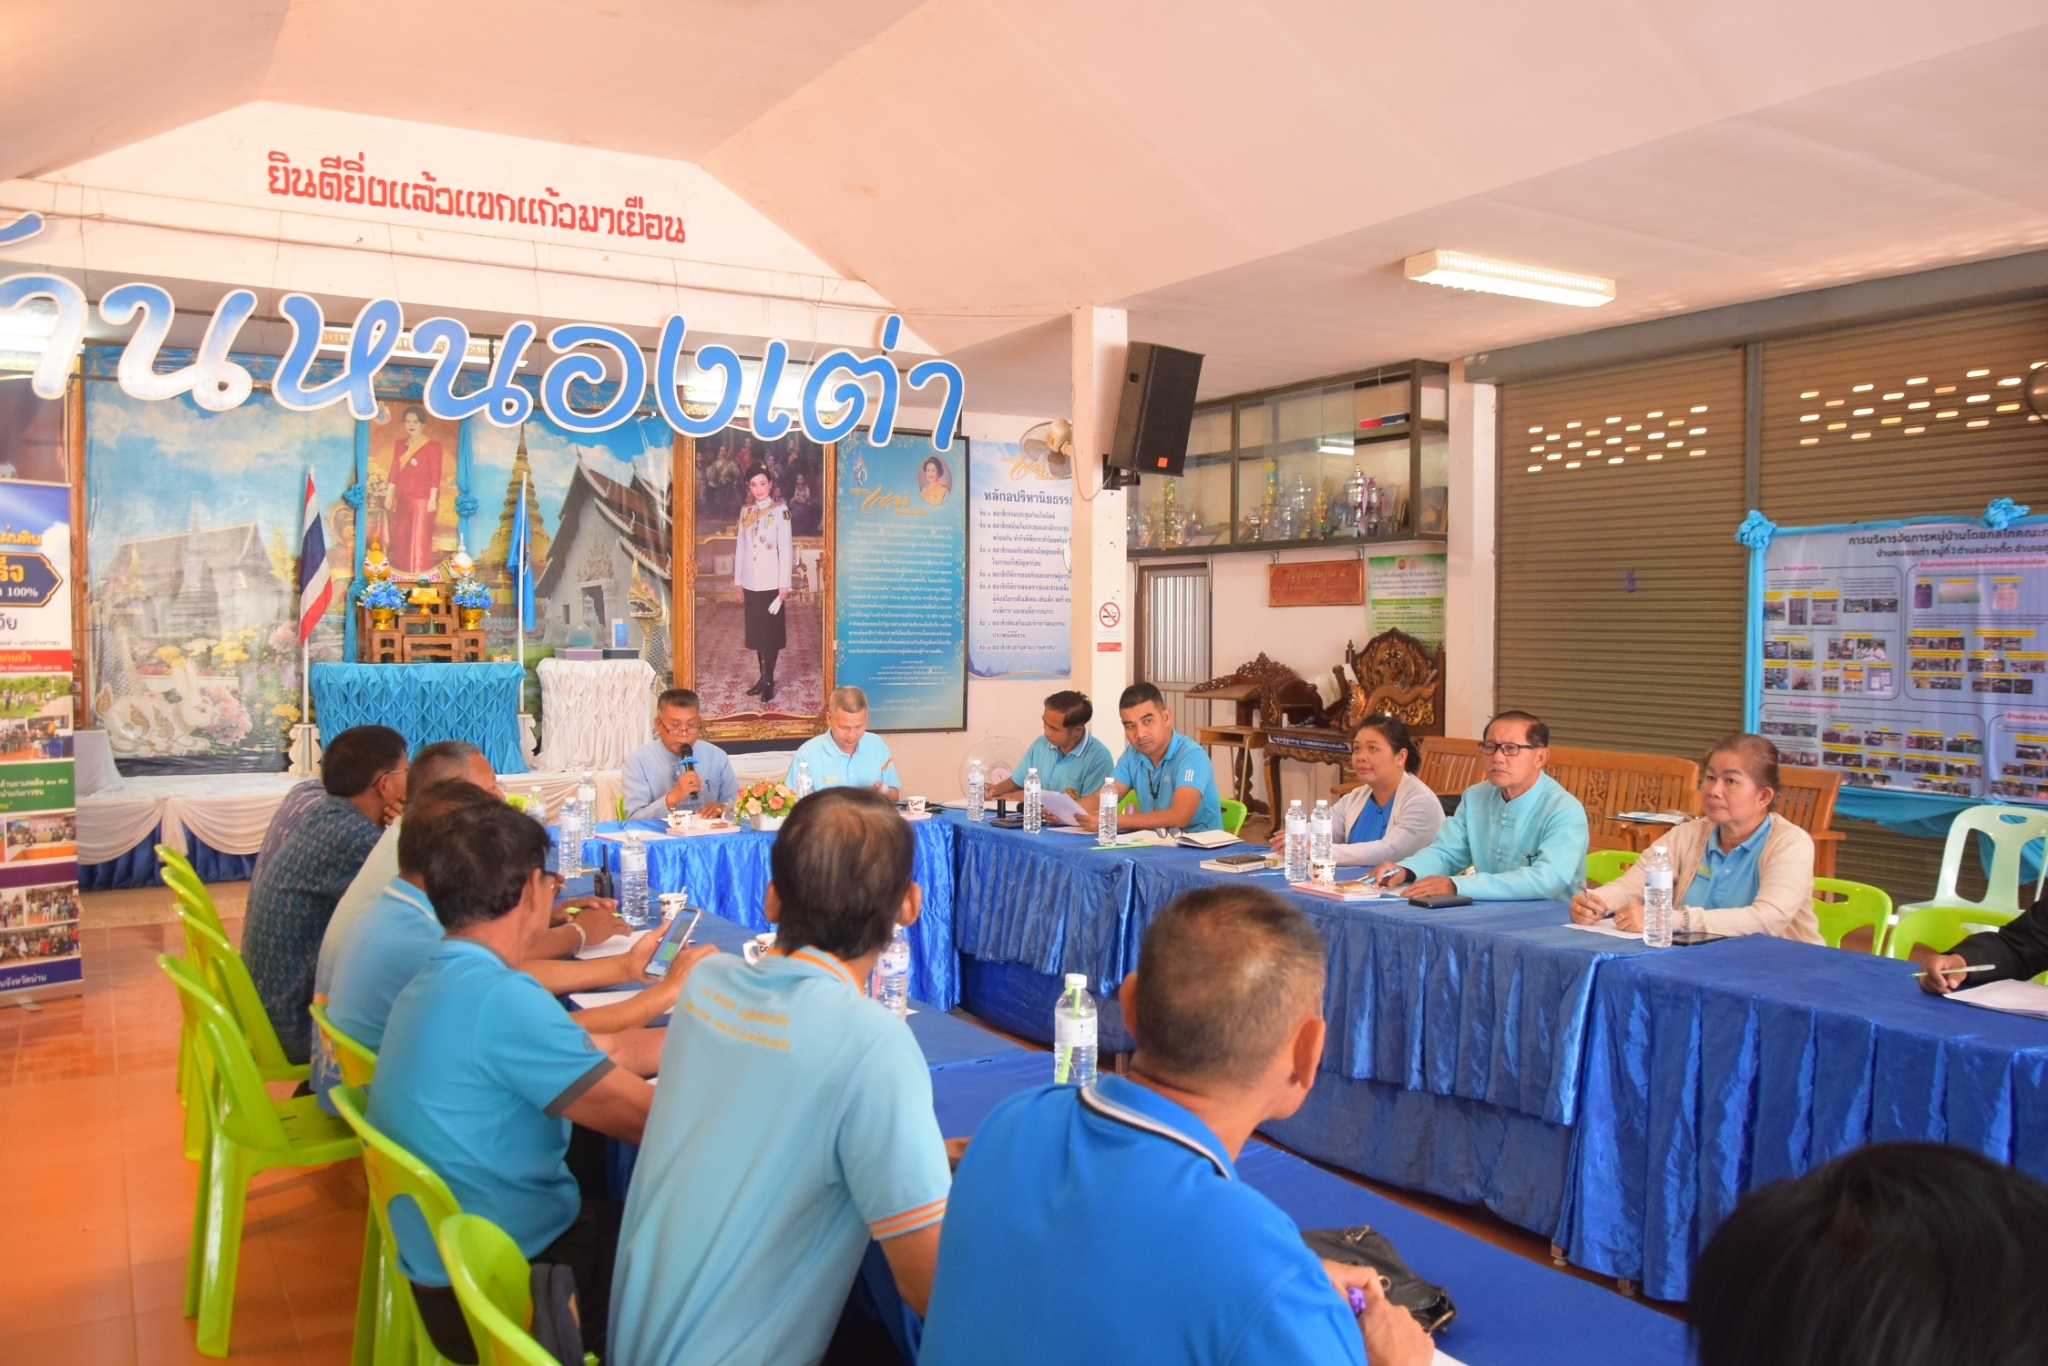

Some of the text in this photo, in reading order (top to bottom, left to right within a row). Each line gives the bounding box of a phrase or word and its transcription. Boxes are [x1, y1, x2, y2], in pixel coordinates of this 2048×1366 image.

[268, 151, 685, 243] ยินดียิ่งแล้วแขกแก้วมาเยือน
[7, 587, 39, 598] 100%
